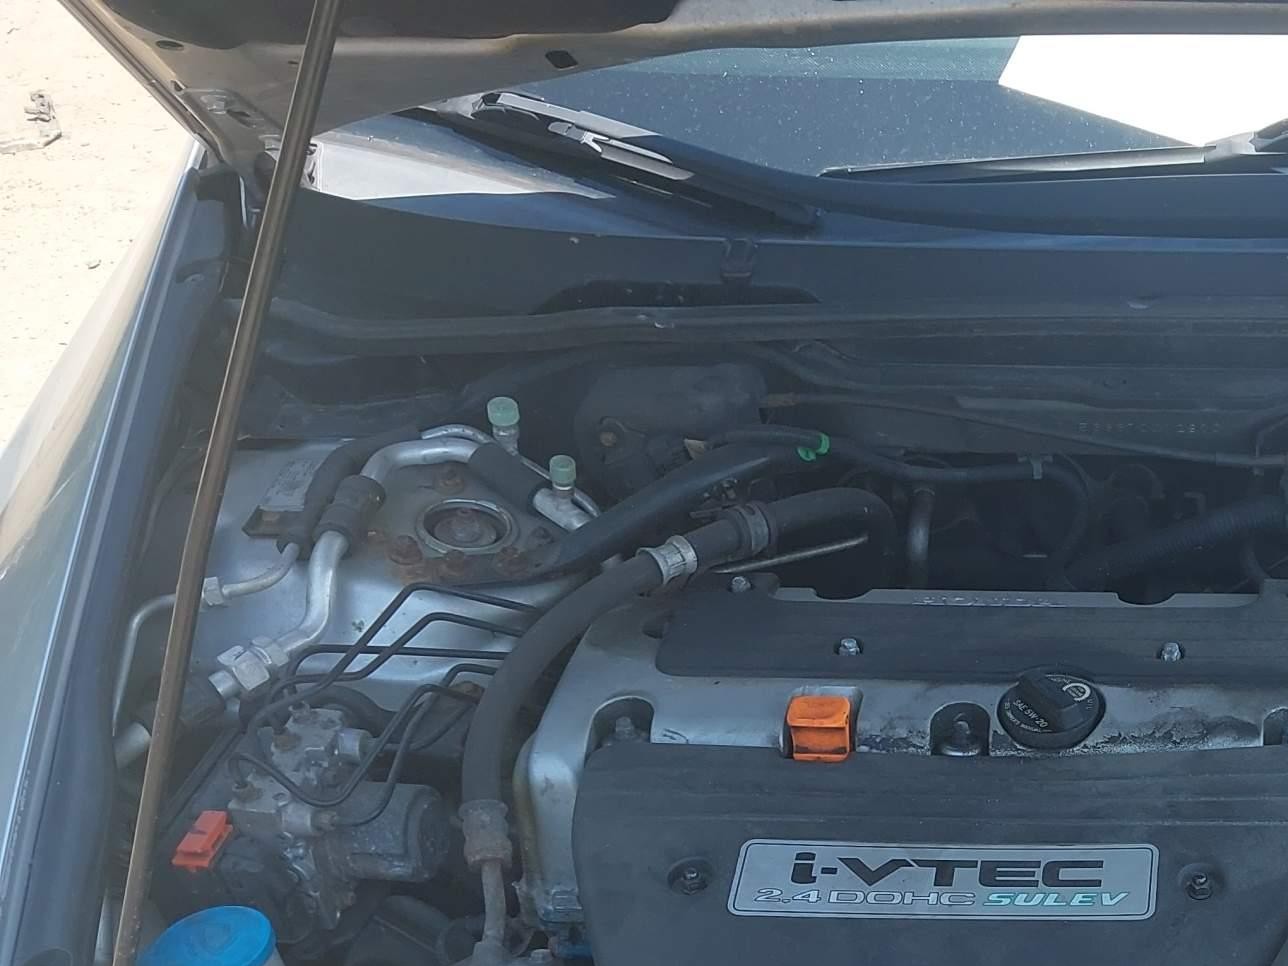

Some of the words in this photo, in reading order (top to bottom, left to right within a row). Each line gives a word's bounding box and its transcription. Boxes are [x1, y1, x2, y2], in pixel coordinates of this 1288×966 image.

[1025, 709, 1049, 728] 5W-20
[789, 851, 1104, 888] i-VTEC
[752, 888, 822, 905] 2.4
[828, 889, 976, 907] DOHC
[982, 892, 1129, 907] SULEV
